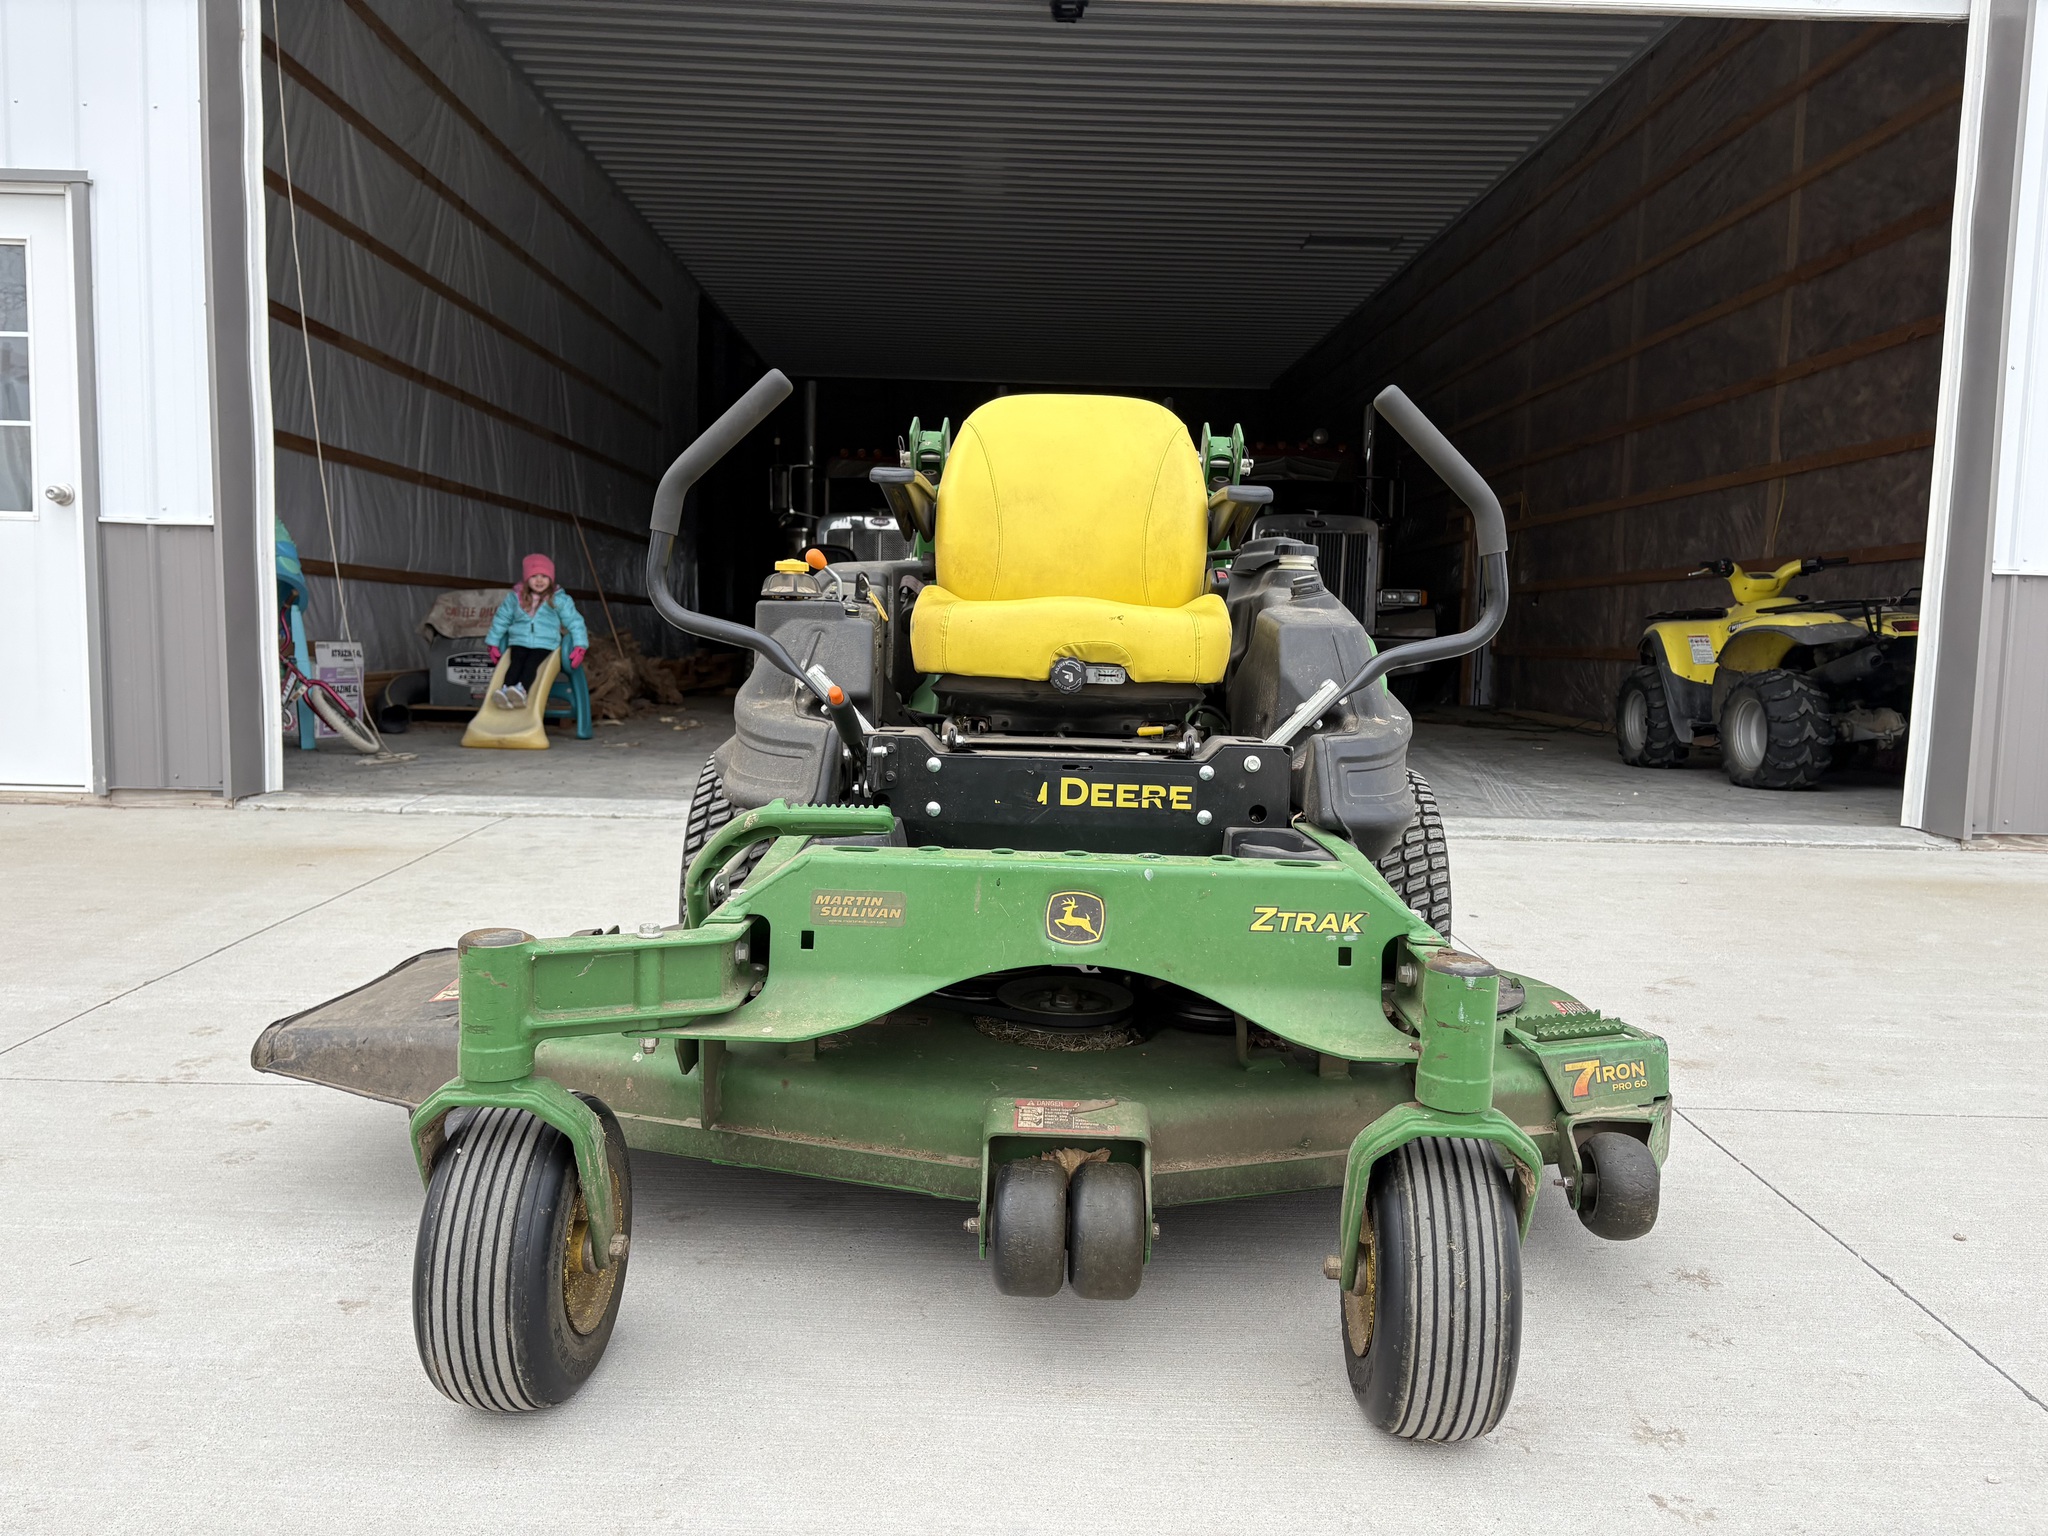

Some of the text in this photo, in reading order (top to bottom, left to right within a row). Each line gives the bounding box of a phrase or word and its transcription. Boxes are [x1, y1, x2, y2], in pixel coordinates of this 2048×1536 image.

[1059, 776, 1193, 810] DEERE
[815, 894, 883, 906] MARTIN
[819, 906, 902, 919] SULLIVAN
[1249, 906, 1365, 934] ZTRAK
[1612, 1079, 1648, 1091] PRO 60
